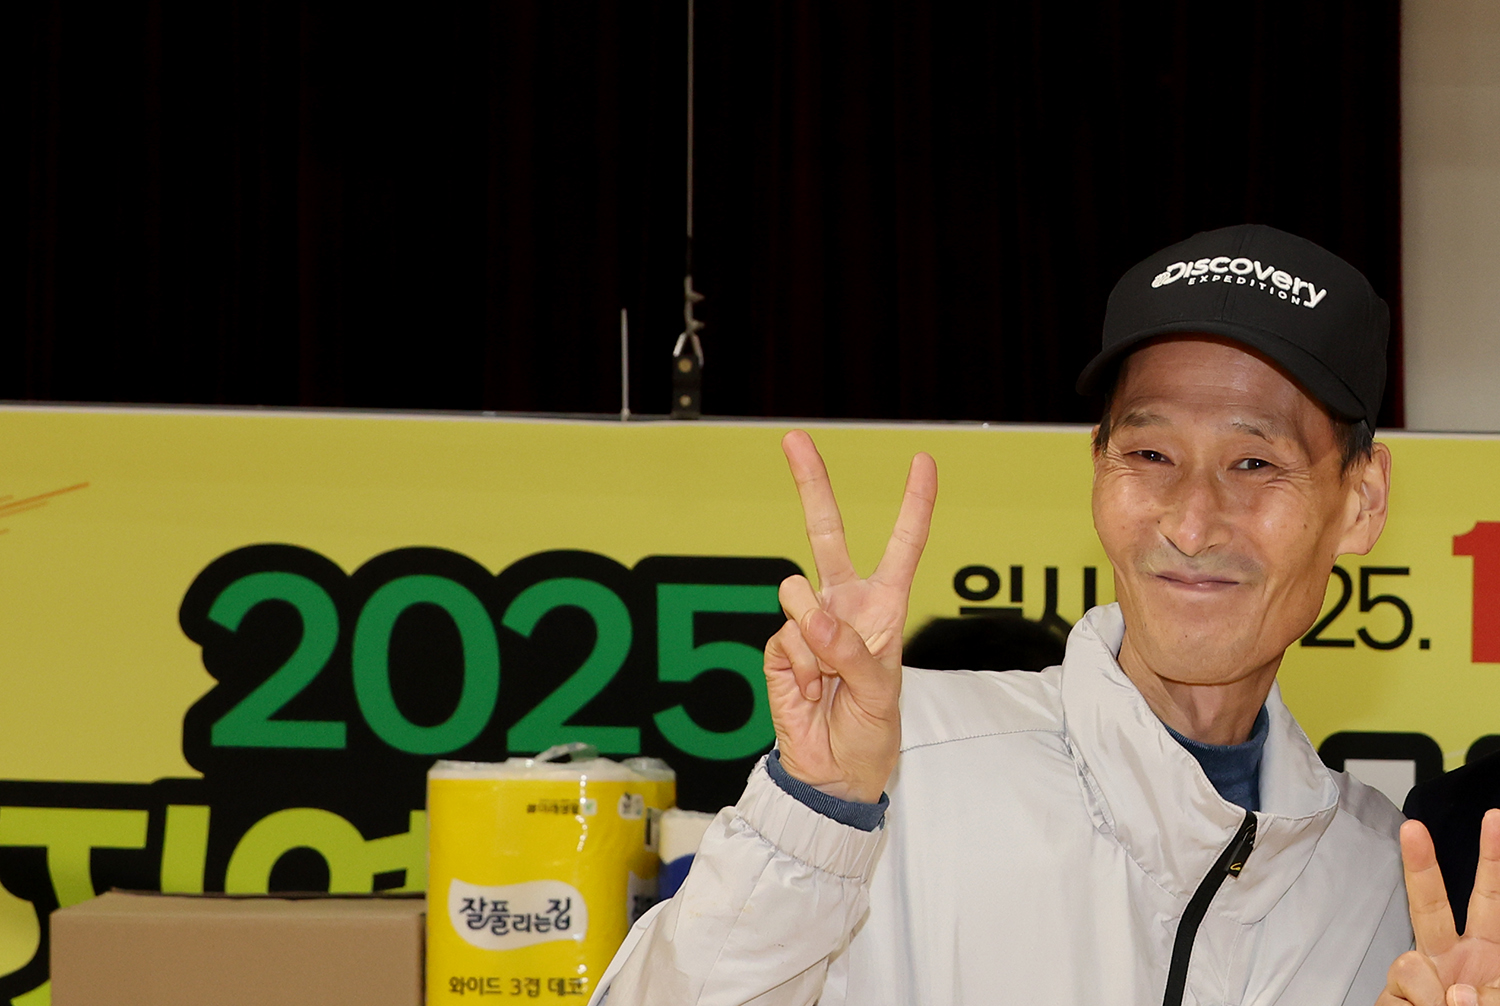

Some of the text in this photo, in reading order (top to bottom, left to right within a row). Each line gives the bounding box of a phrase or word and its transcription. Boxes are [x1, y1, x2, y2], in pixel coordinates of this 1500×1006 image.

[1187, 275, 1301, 306] EXPEDITION
[207, 571, 782, 760] 2025
[449, 976, 503, 996] 와이드
[509, 977, 541, 998] 3겹
